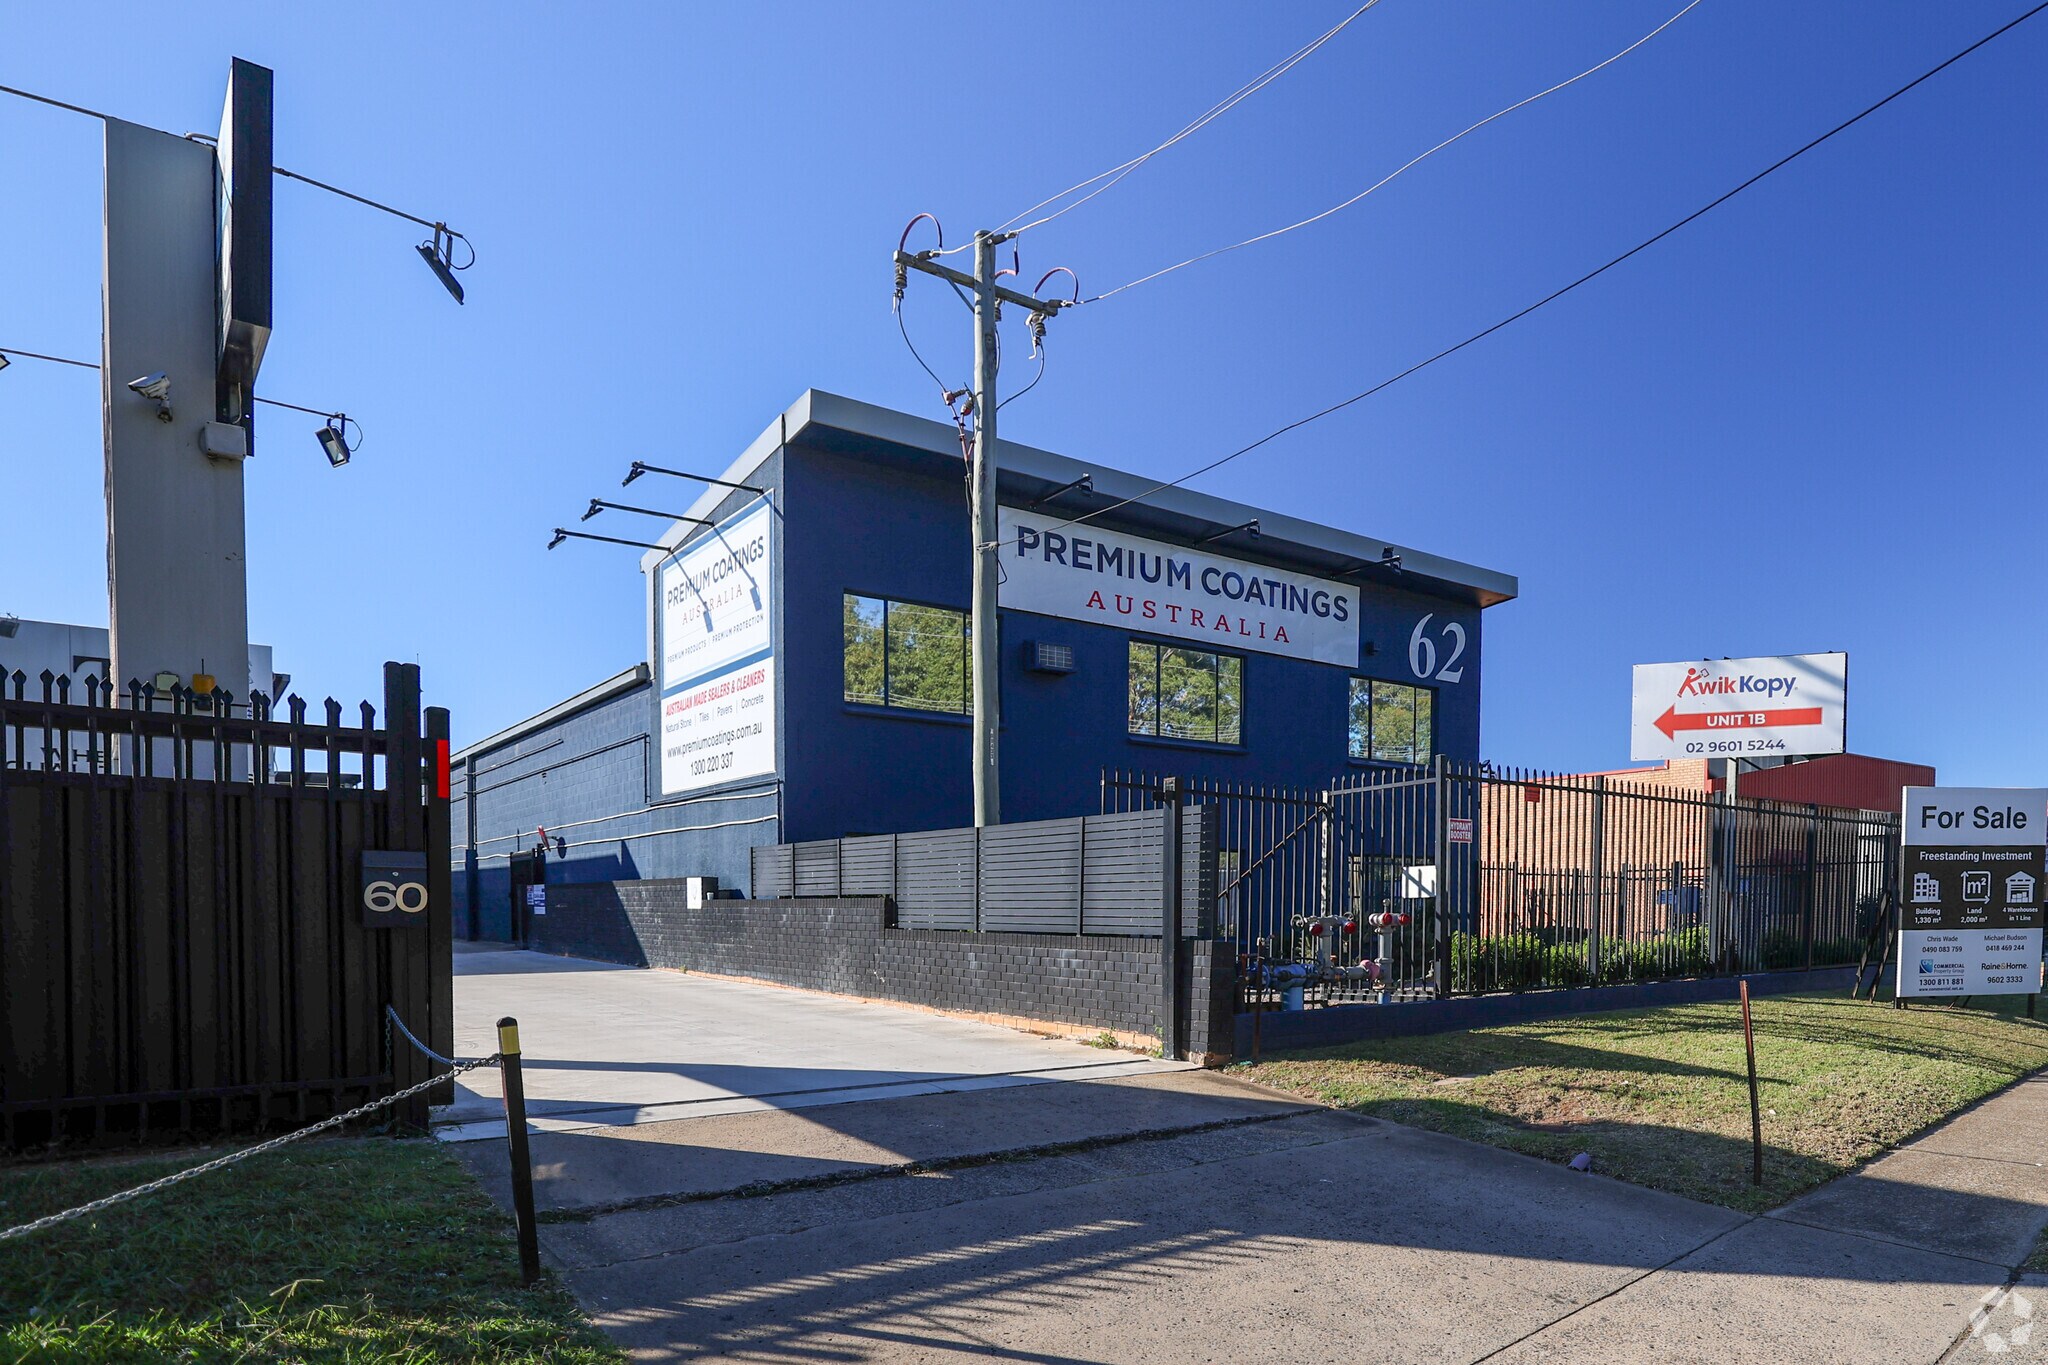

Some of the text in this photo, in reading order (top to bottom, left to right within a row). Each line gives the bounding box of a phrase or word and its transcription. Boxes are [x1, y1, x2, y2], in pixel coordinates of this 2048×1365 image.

[667, 536, 765, 610] PREMIUM COATINGS
[1016, 525, 1349, 622] PREMIUM COATINGS
[682, 584, 743, 625] AUSRALIA
[1086, 590, 1291, 644] AUSTRALIA
[667, 613, 764, 663] PREMIUM PRODUCTS PREMIUM PROTECTION
[1408, 613, 1467, 684] 62
[666, 668, 765, 717] AUSTRALIAN MADE SEALERS & CLEANERS
[1677, 668, 1797, 698] Kwik Kopy
[666, 694, 764, 733] Natural Stone Tiles Pavers Concrete
[1706, 713, 1766, 727] UNIT 1B
[667, 722, 762, 758] www.premiumcoatings.com.au
[1685, 739, 1786, 753] 02 9601 5244
[690, 751, 734, 776] 1300 220 337
[1450, 822, 1471, 831] HYDRANT
[1921, 805, 2028, 829] For Sale
[1450, 830, 1471, 839] BOOSTER
[1919, 851, 2033, 862] Freestanding Investment
[363, 880, 428, 913] 60
[1960, 916, 1978, 924] 2,000
[1919, 978, 1936, 986] 1300
[2005, 975, 2024, 983] 3333
